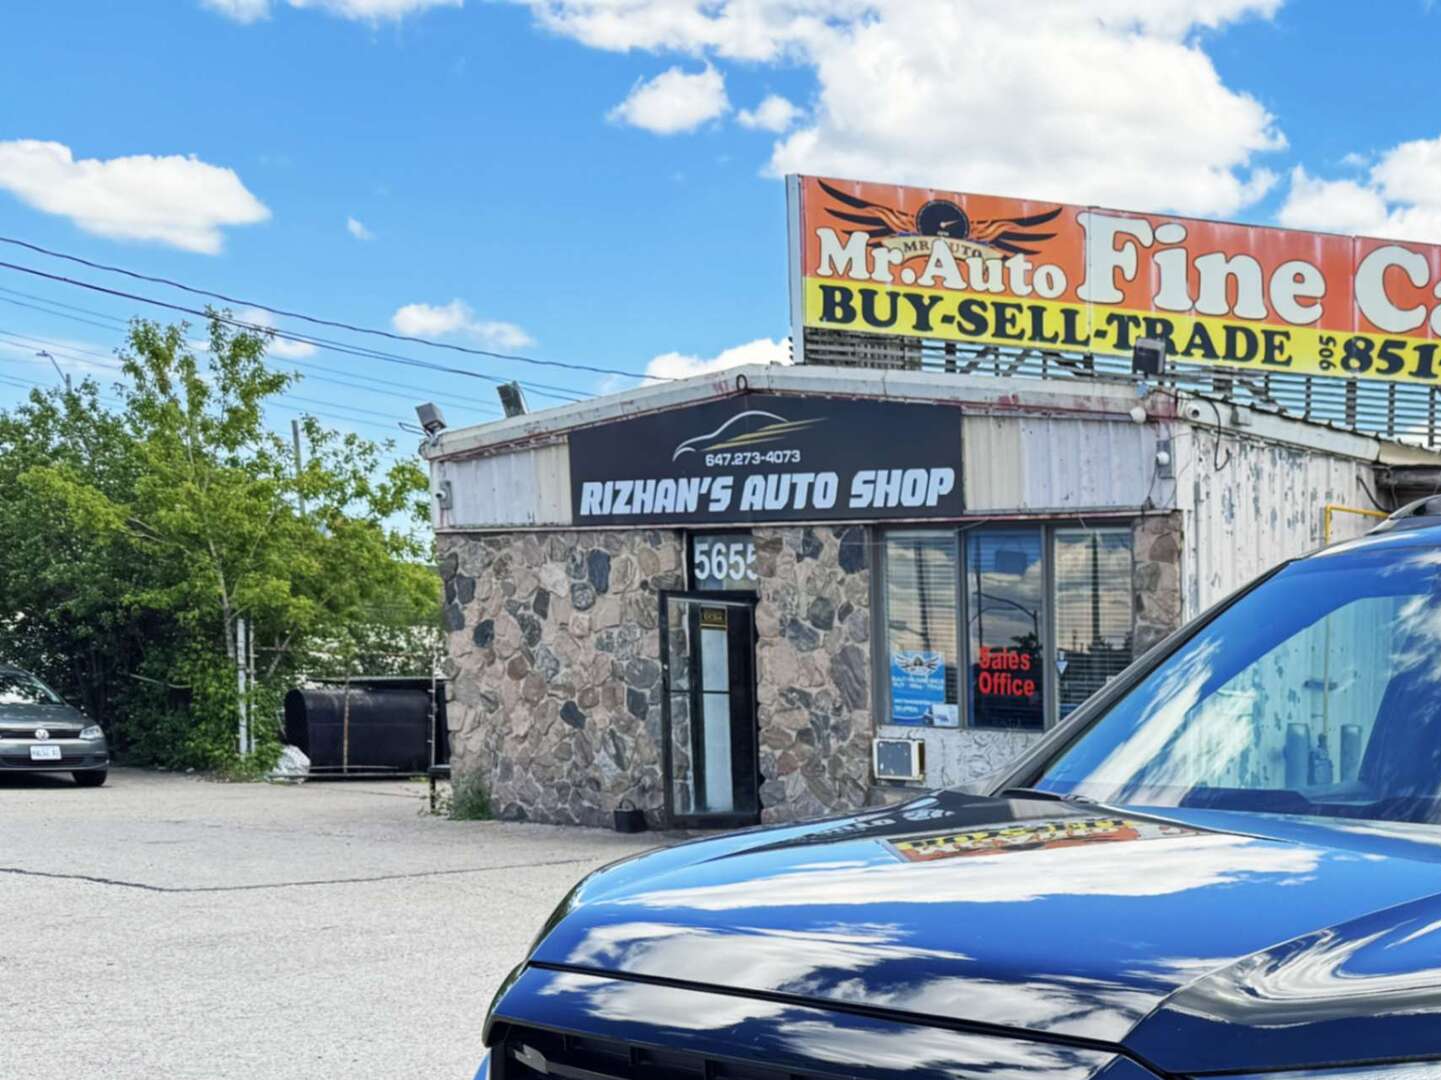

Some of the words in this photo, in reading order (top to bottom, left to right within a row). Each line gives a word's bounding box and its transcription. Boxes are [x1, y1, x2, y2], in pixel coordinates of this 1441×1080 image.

[1076, 210, 1327, 325] Fine
[1318, 335, 1337, 371] 905
[580, 475, 733, 515] RIZHAN'S
[740, 471, 839, 511] AUTO
[849, 467, 955, 508] SHOP
[979, 646, 1031, 670] Sales
[979, 671, 1035, 696] Office
